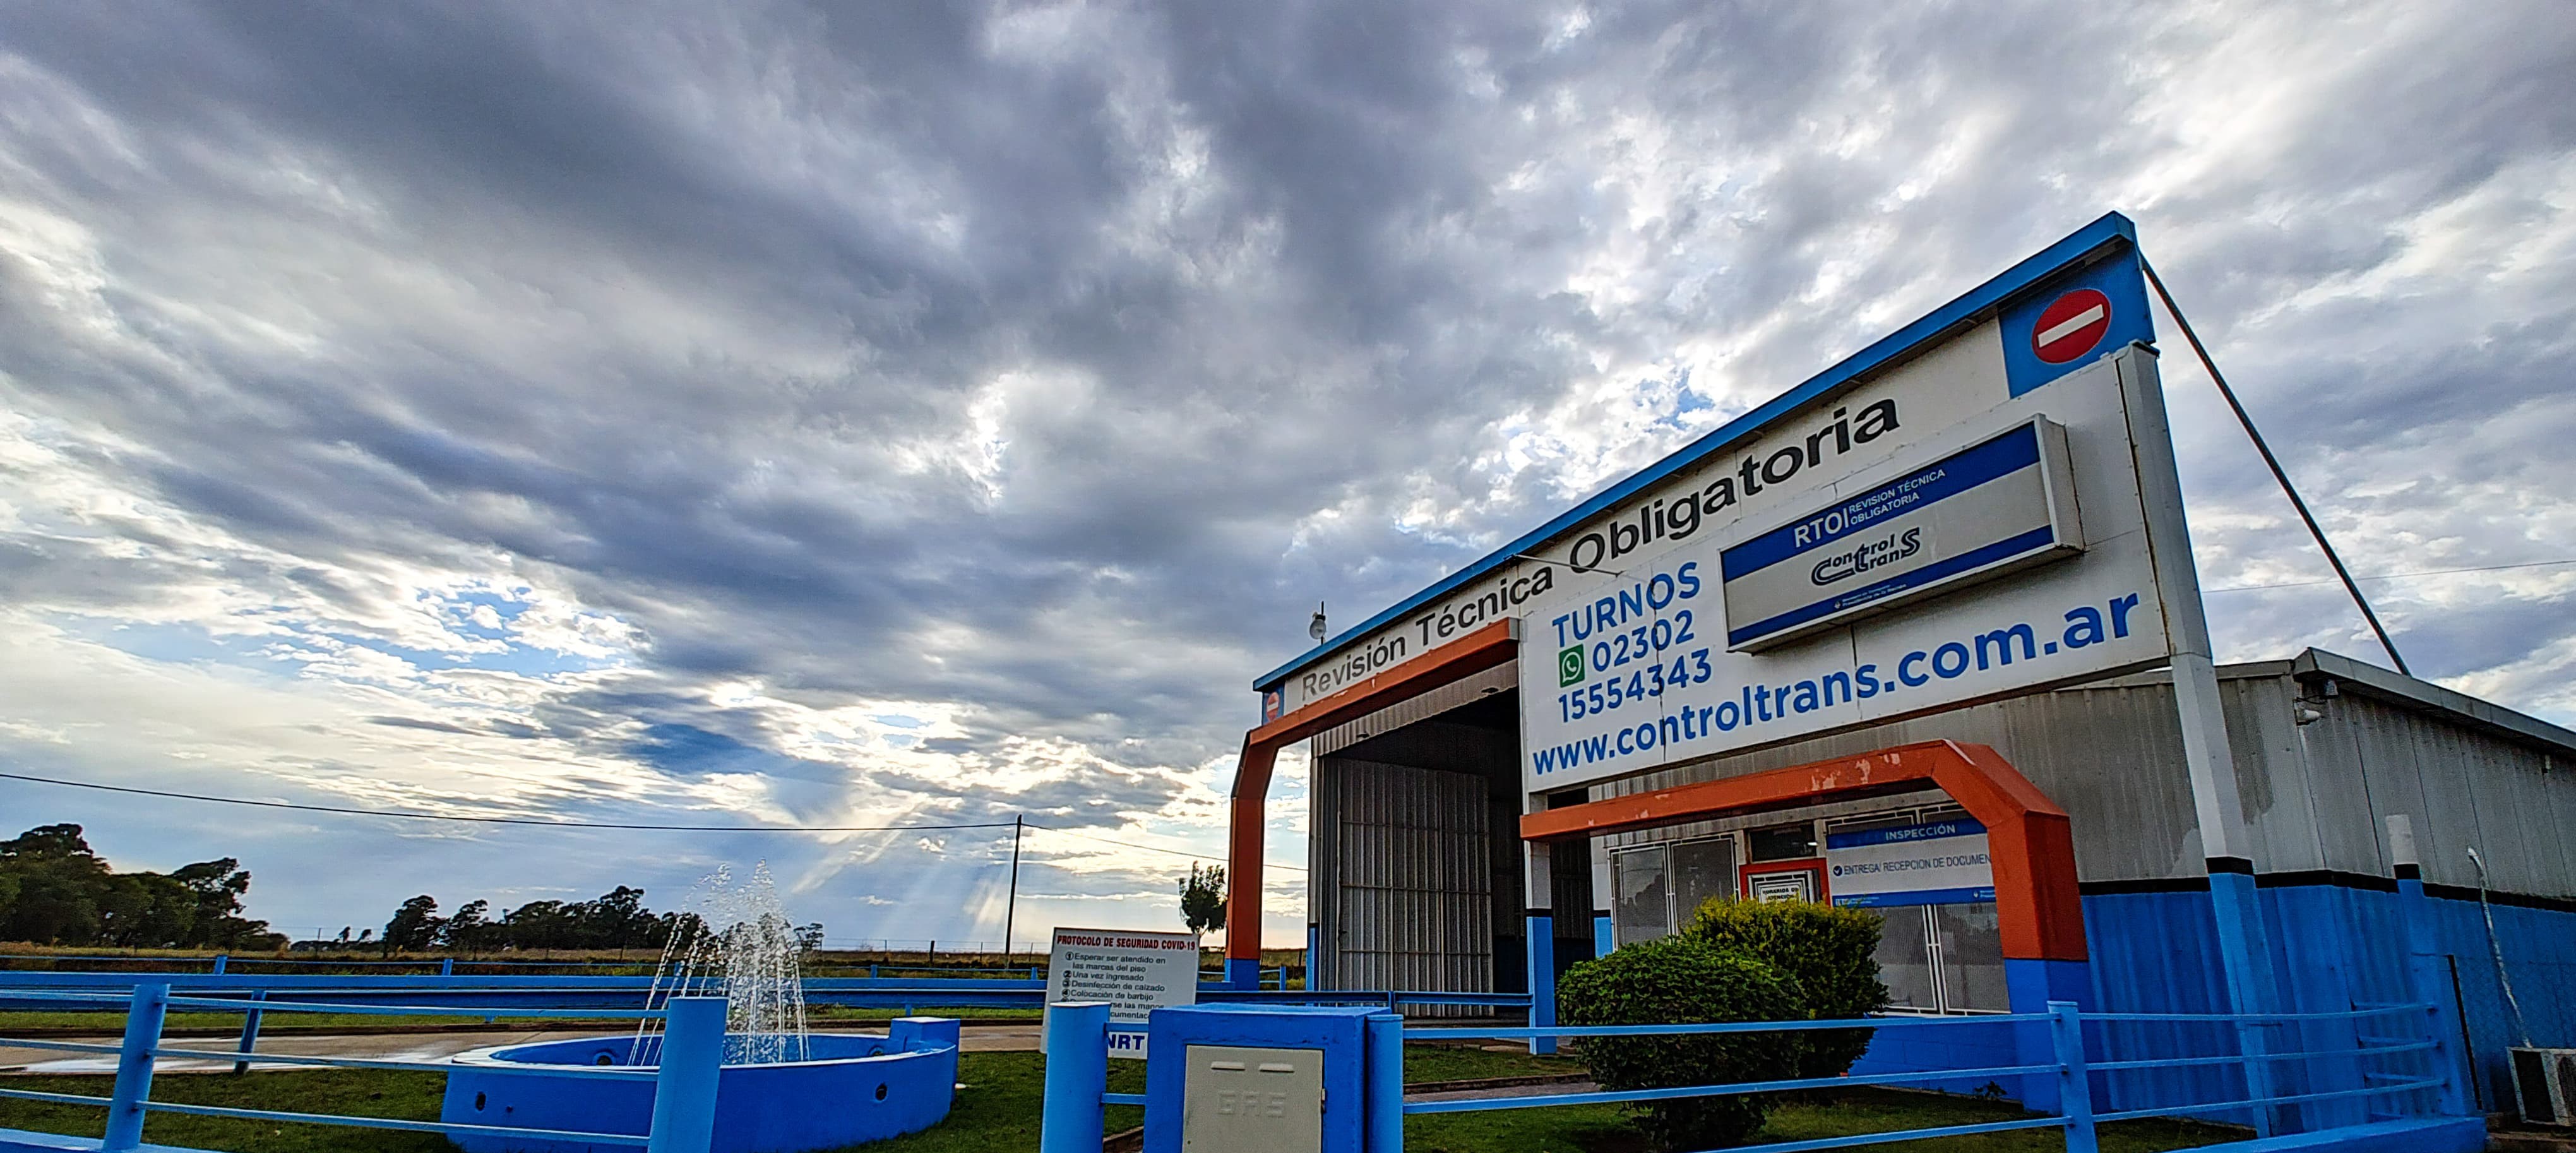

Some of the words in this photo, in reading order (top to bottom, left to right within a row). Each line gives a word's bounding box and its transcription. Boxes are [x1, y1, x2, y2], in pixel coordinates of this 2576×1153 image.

[1794, 512, 1843, 548] RTO
[1849, 488, 1895, 514] REVISION
[1897, 469, 1946, 495] TÉCNICA
[1850, 492, 1920, 525] OBLIGATORIA
[1302, 635, 1406, 702] Revisión
[1416, 566, 1553, 647] Técnica
[1569, 398, 1901, 573] Obligatoria
[1552, 561, 1700, 648] TURNOS
[1592, 609, 1695, 672] 02302
[1533, 592, 2139, 775] www.controltrans.com.ar
[1558, 648, 1712, 723] 15554343
[1885, 824, 1955, 840] INSPECCIÓN
[1883, 859, 1931, 872] RECEPCION
[1933, 857, 1945, 868] DE
[1947, 853, 1991, 867] DOCUMEN
[1057, 935, 1100, 947] PROTOCOLO
[1104, 937, 1113, 947] DE
[1116, 938, 1159, 949] SEGURIDAD
[1162, 940, 1195, 950] COVID-19
[1075, 953, 1104, 962] Esperar
[1121, 955, 1154, 964] atendido
[1106, 973, 1144, 982] ingresado
[1130, 965, 1146, 974] piso
[1071, 981, 1119, 990] Desinfección
[1135, 983, 1165, 991] calzado
[1071, 989, 1112, 999] Colocación
[1127, 992, 1154, 1001] barbijo
[1110, 1010, 1149, 1019] cumentac
[1107, 1034, 1145, 1050] NRT
